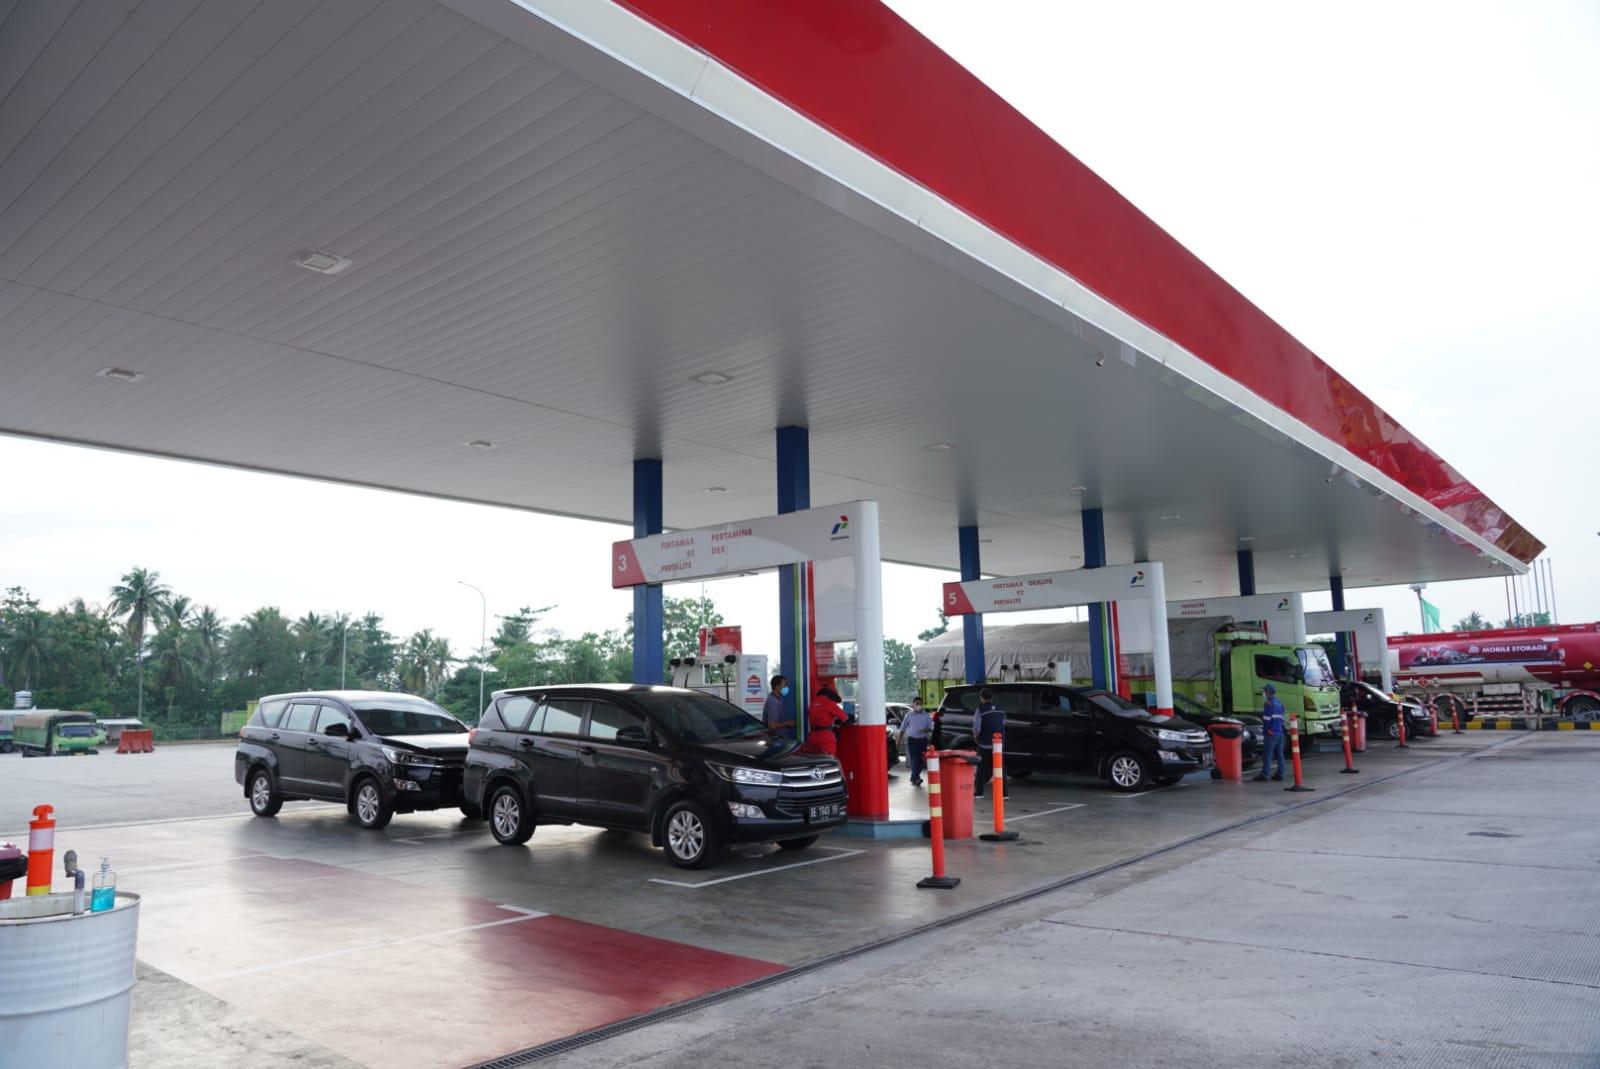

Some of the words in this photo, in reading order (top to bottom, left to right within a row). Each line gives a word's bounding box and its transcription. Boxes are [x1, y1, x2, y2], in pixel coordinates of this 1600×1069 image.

[711, 528, 753, 541] PERTAMINA
[660, 537, 695, 550] PERTAMAX
[711, 546, 726, 555] DEX
[618, 554, 628, 571] 3
[660, 561, 692, 573] PERTALITE
[992, 581, 1023, 590] PERTAMAX
[1028, 578, 1053, 587] DEXLITE
[948, 592, 957, 605] 5
[993, 597, 1022, 606] PERTALITE
[1481, 645, 1511, 653] MOBILE
[1512, 644, 1547, 653] STORAGE
